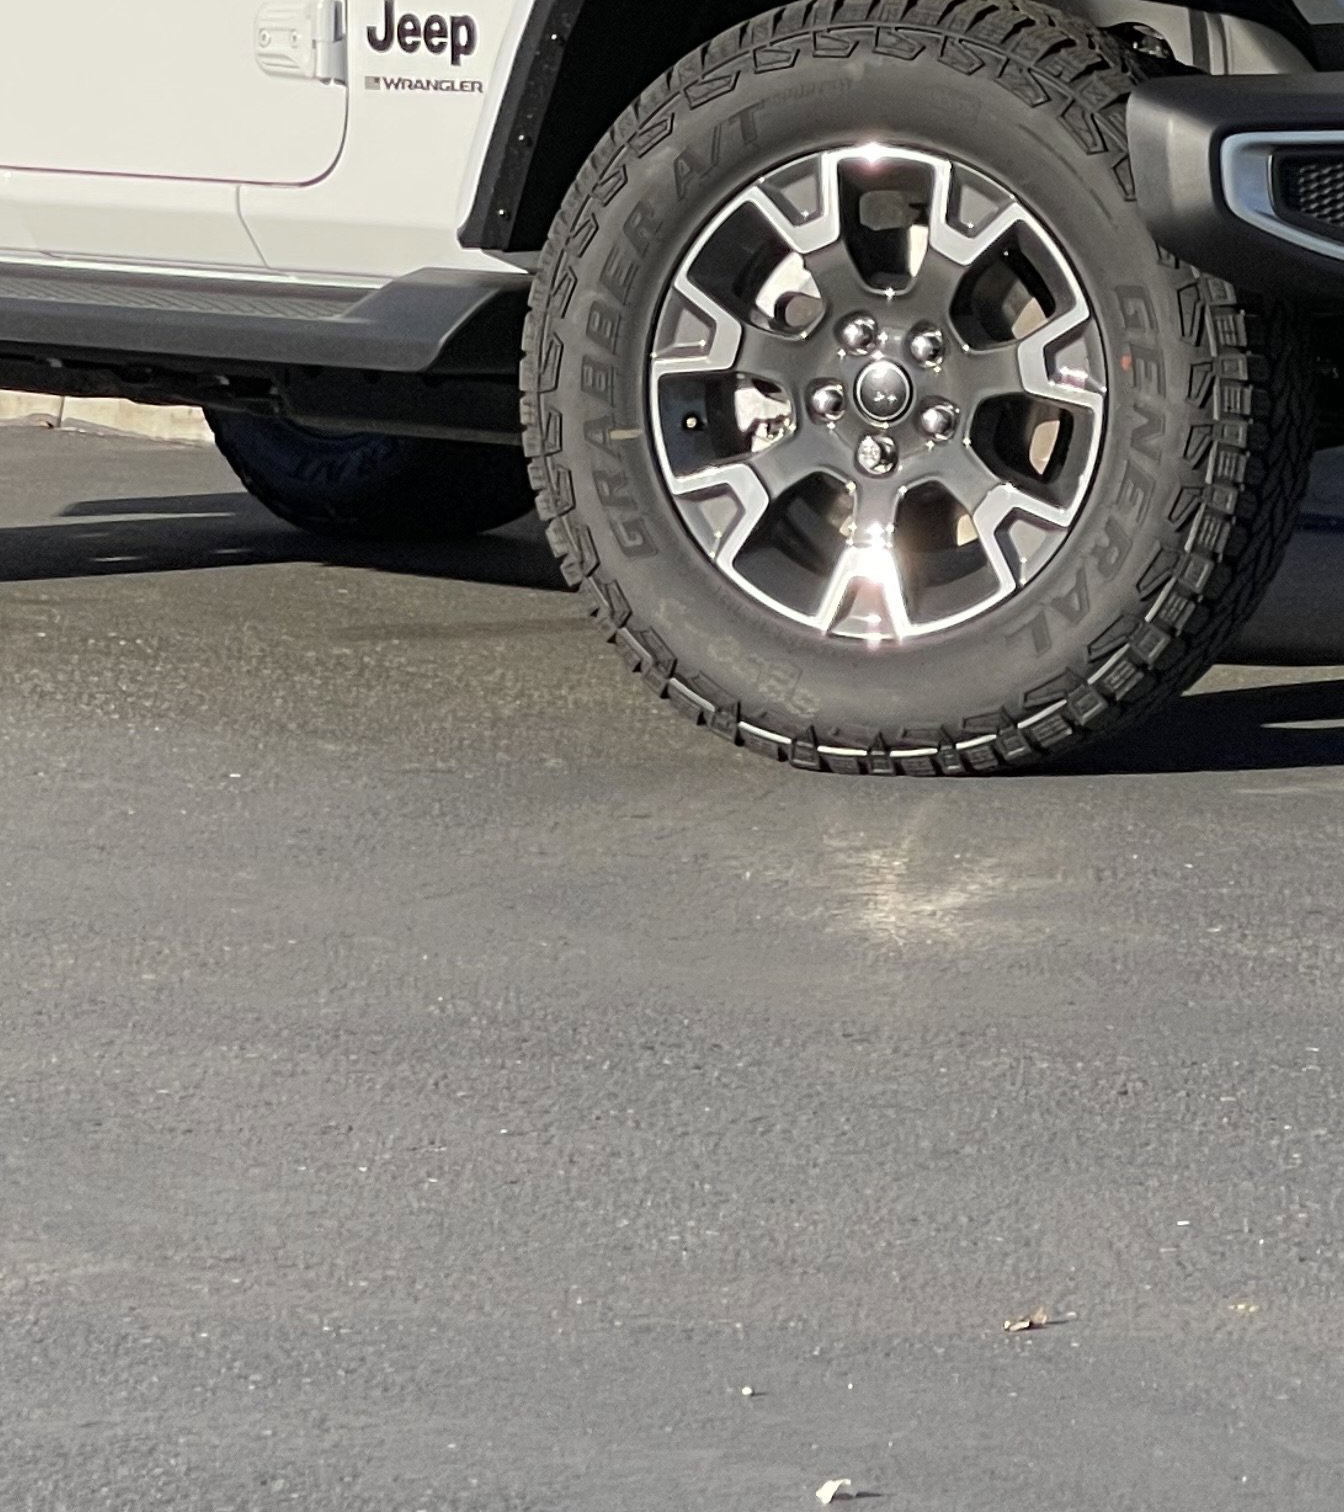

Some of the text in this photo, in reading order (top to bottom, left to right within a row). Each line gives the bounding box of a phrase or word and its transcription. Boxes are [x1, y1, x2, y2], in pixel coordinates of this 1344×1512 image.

[382, 76, 484, 93] WRANGLER
[581, 200, 663, 559] GRABBER
[1006, 285, 1166, 657] GENERAL
